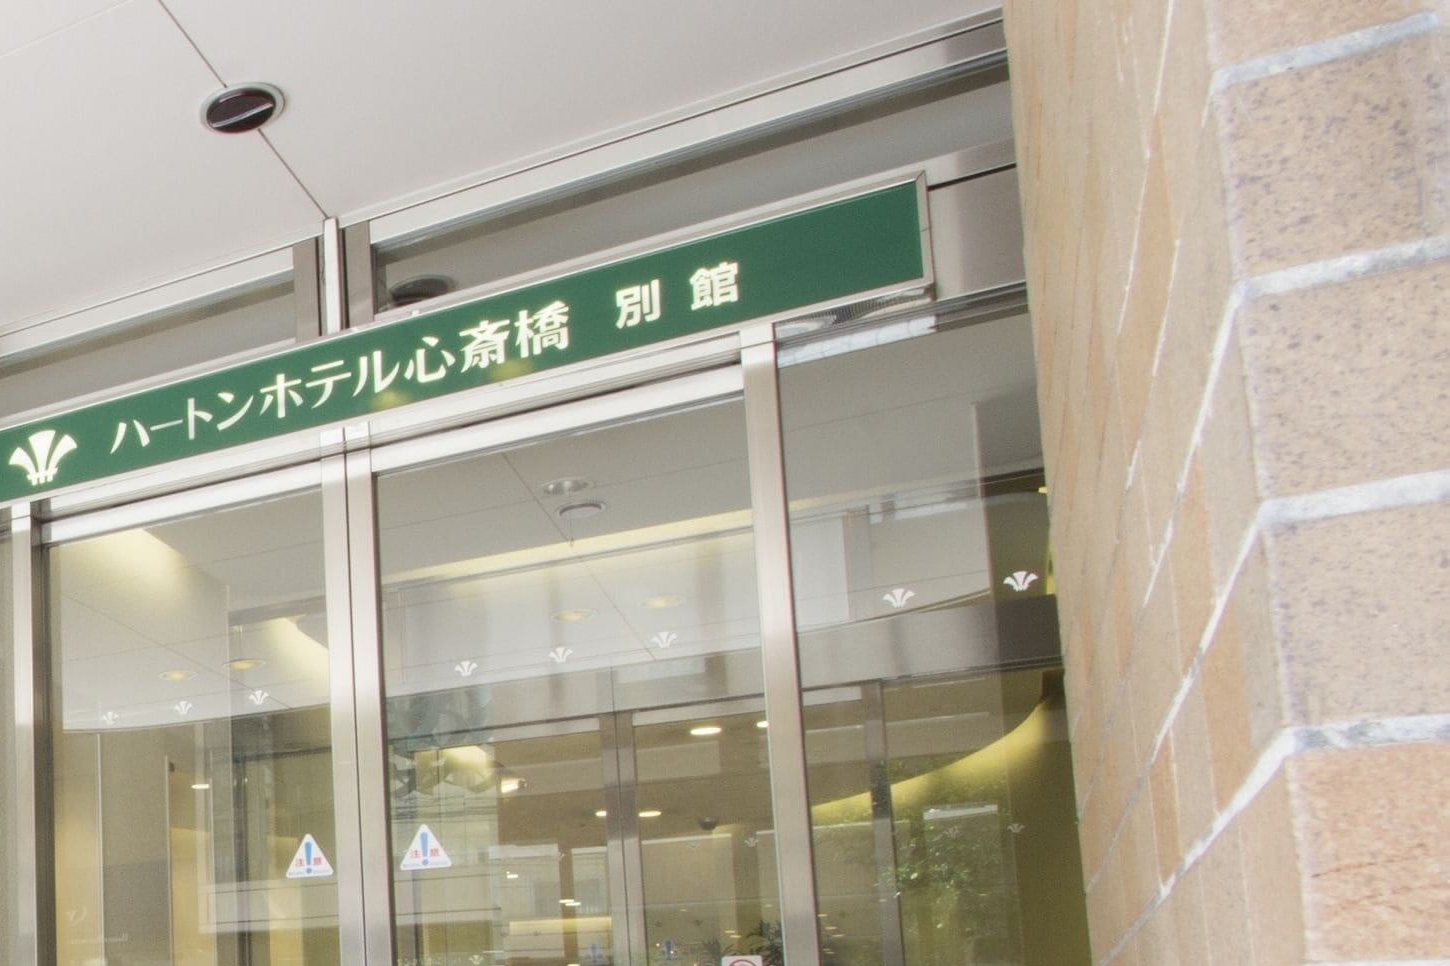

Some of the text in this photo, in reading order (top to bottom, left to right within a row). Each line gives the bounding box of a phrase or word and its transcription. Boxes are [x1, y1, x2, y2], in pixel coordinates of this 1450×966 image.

[110, 261, 739, 455] ハートンホテル心斎橋 別館
